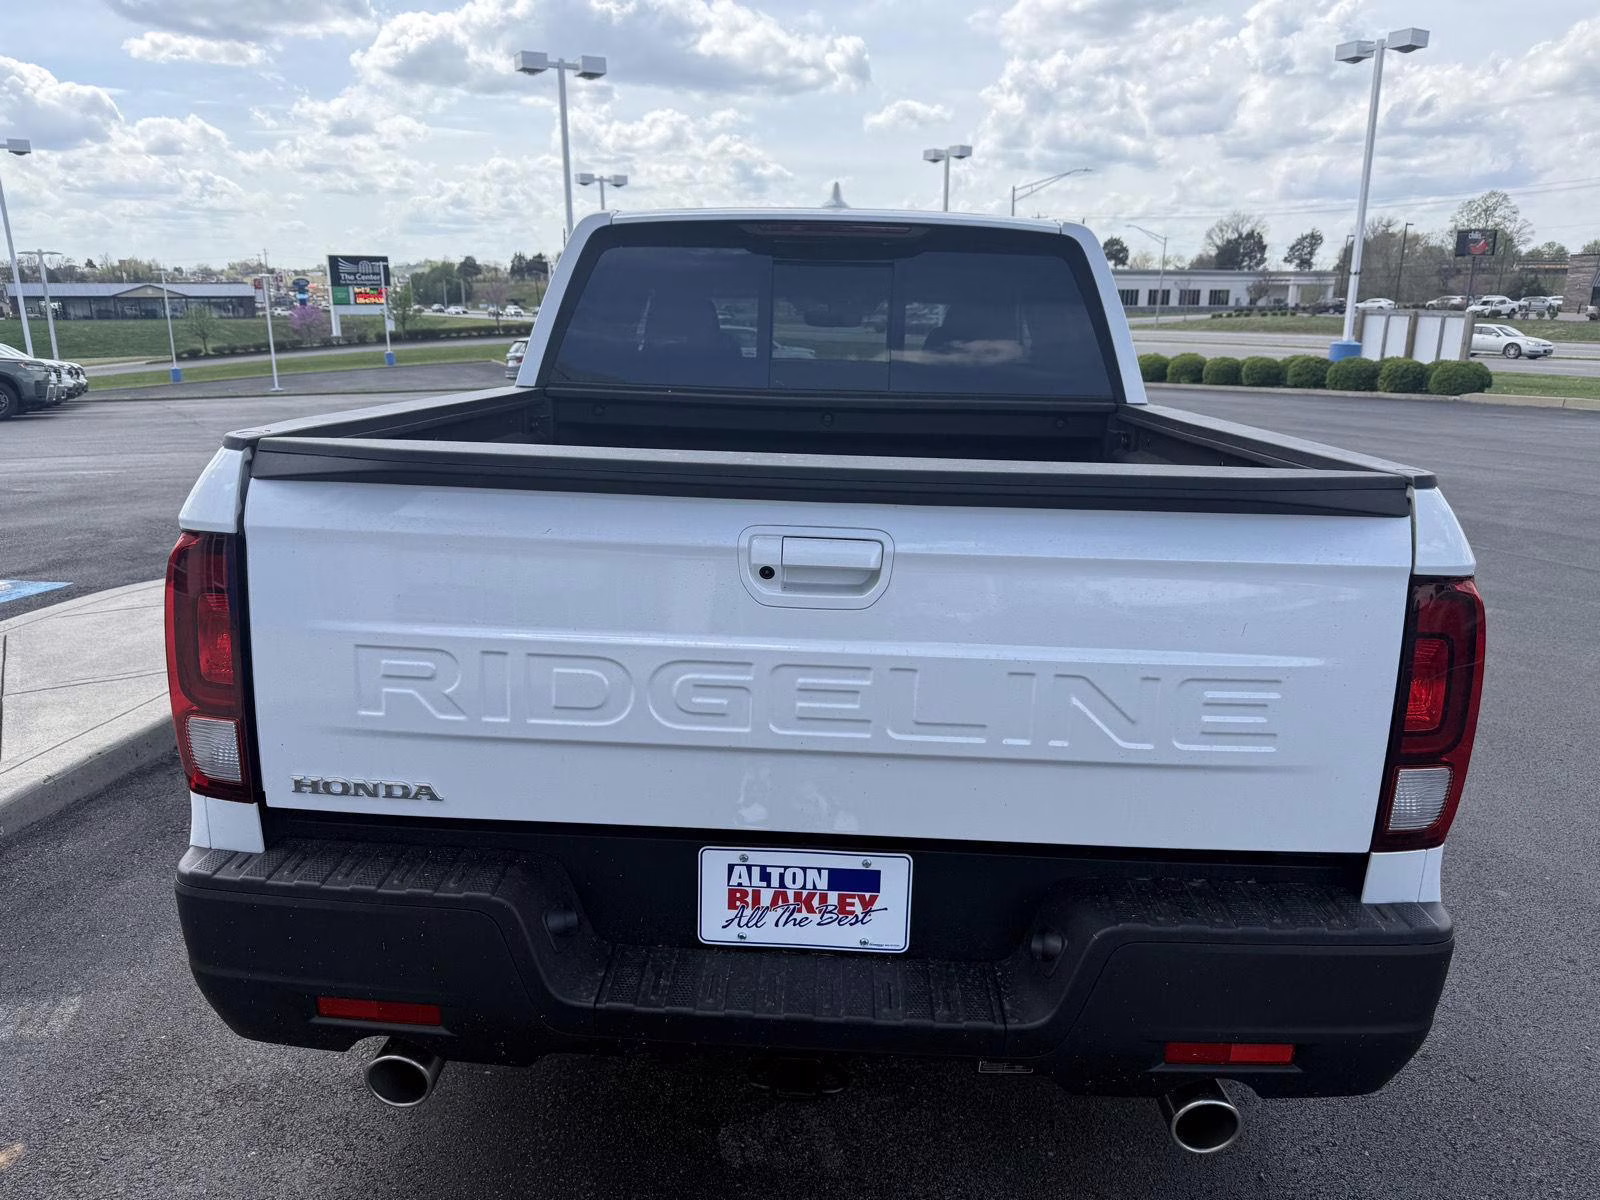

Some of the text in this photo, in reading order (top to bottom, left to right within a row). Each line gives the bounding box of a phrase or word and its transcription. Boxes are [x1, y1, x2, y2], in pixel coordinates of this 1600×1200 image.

[355, 273, 381, 281] Center
[354, 644, 1283, 754] RIDGELINE
[291, 775, 444, 801] HONDA
[728, 865, 828, 890] ALTON
[728, 888, 880, 916] BLAKLEY
[722, 903, 888, 929] All The Best
